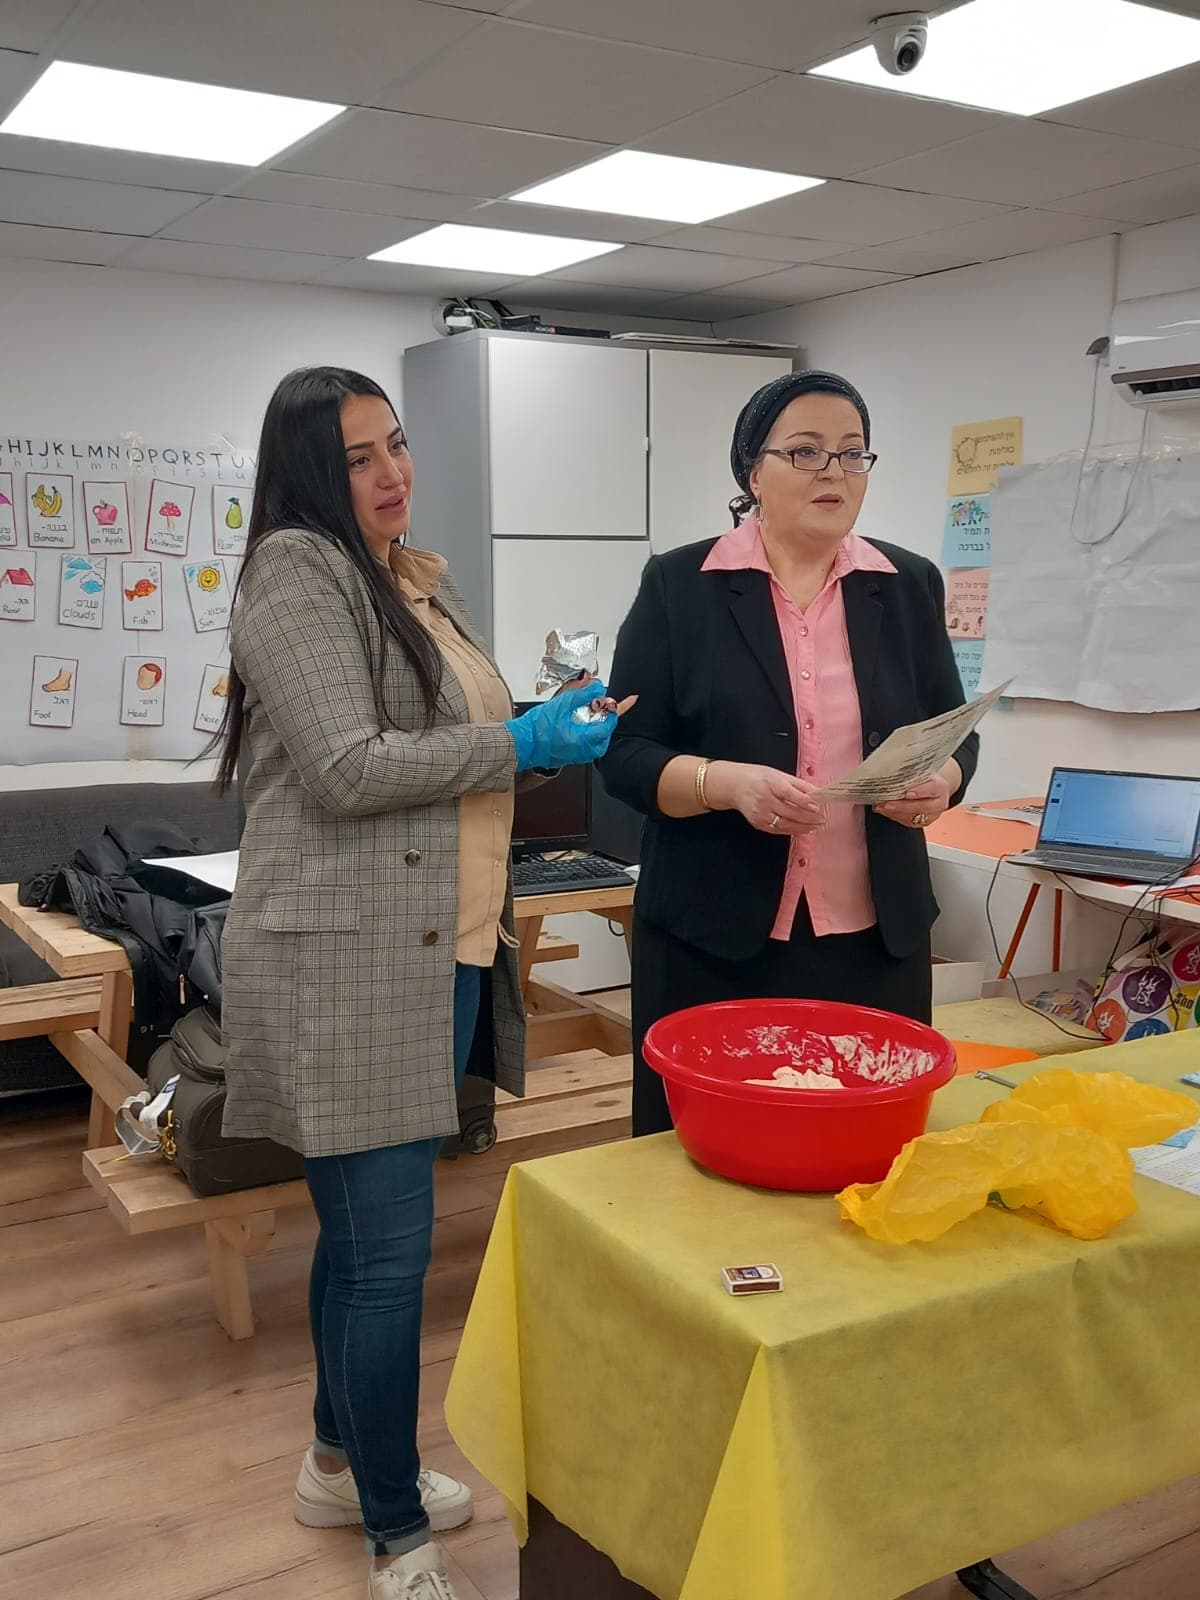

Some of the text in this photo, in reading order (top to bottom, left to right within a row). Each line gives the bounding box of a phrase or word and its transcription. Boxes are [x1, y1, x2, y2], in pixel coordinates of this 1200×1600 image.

[33, 532, 64, 543] Banana
[62, 608, 97, 620] Clouds
[132, 616, 149, 625] Fish
[199, 618, 215, 630] Sun
[33, 709, 51, 719] Foot
[127, 708, 148, 718] Head
